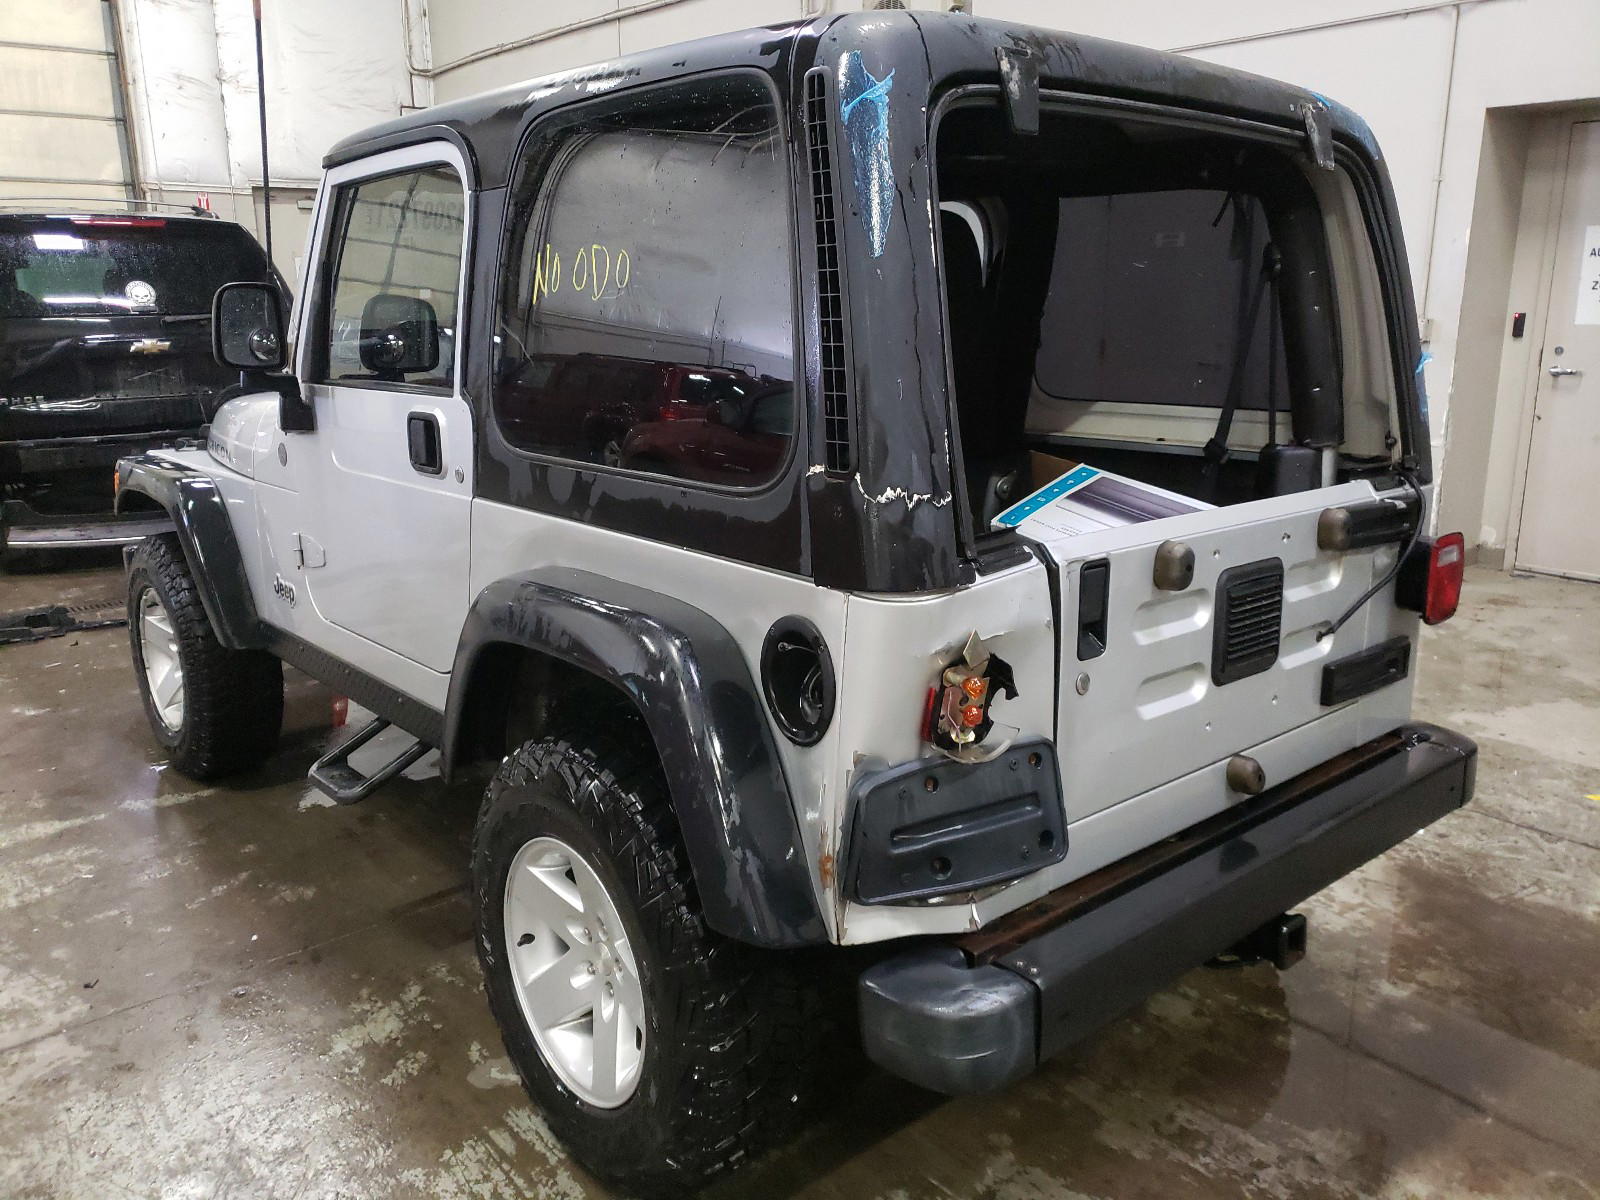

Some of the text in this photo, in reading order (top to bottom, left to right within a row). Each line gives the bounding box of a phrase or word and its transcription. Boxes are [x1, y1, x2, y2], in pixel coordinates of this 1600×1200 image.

[532, 243, 630, 305] NO ODO
[273, 573, 297, 609] Jeep
